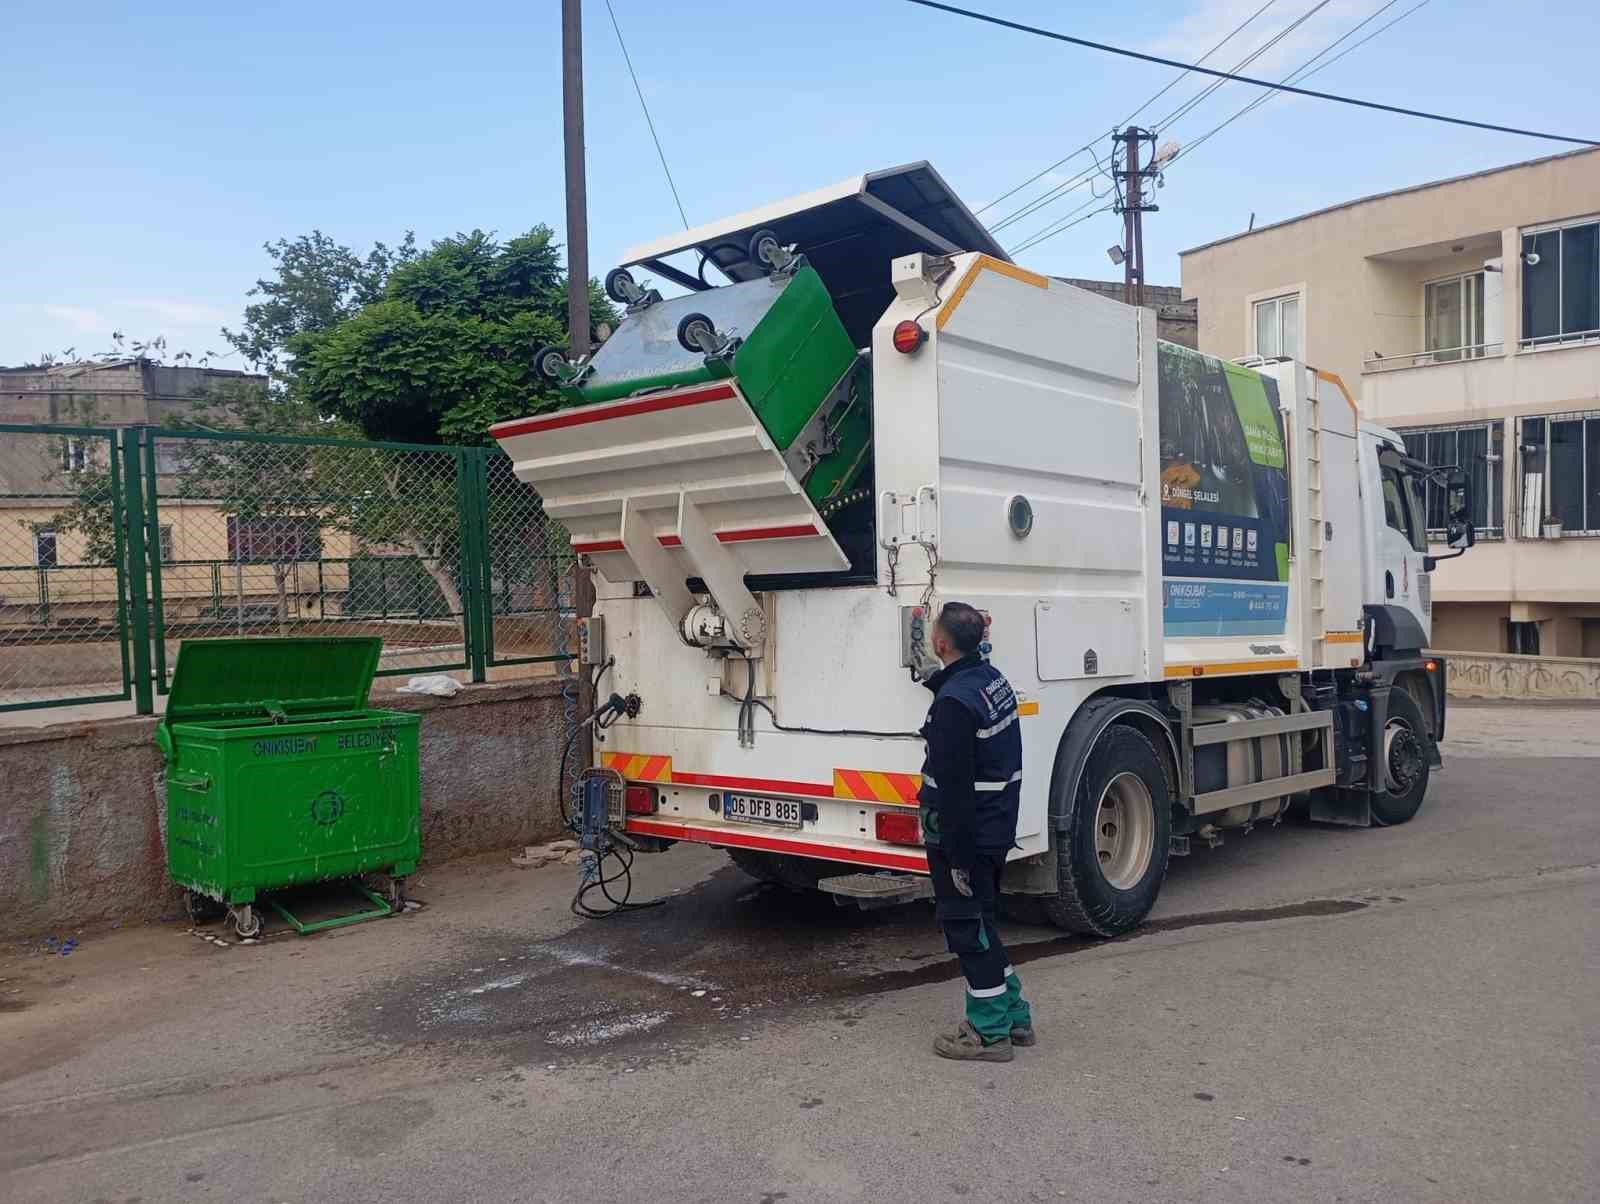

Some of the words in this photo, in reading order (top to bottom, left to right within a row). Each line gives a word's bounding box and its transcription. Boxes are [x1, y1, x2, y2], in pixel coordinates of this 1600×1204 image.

[732, 798, 745, 814] 06
[750, 799, 771, 817] DFB
[776, 803, 798, 820] 885
